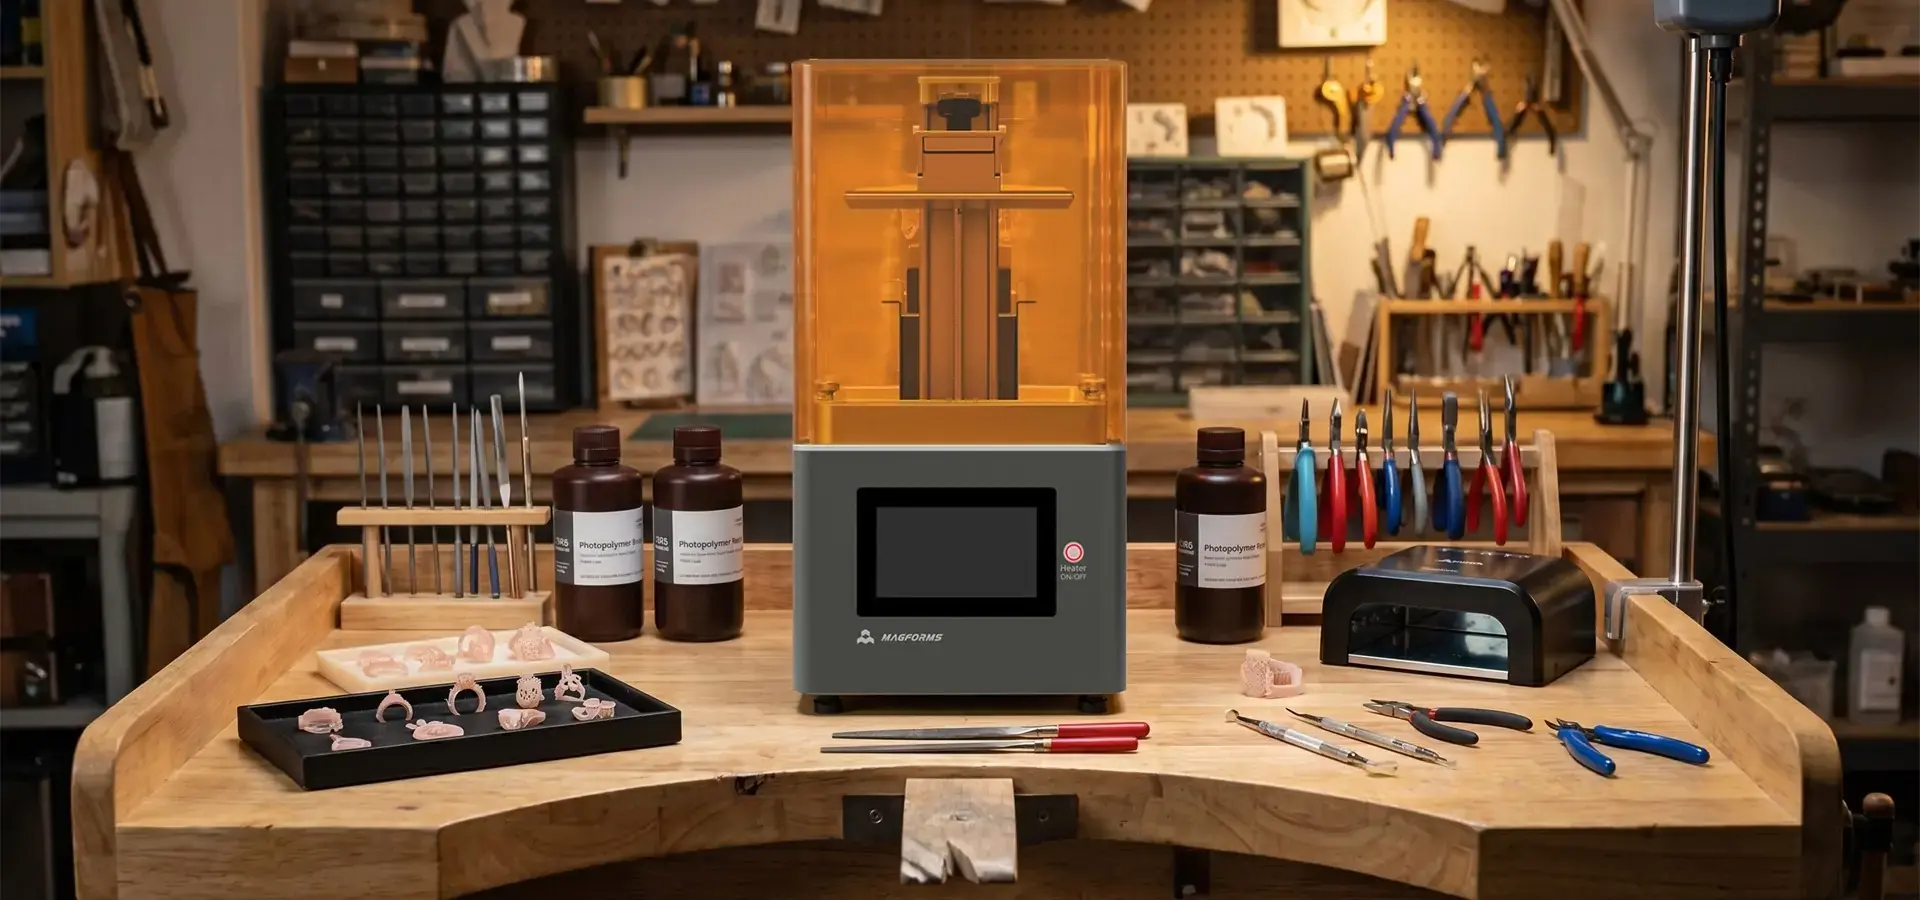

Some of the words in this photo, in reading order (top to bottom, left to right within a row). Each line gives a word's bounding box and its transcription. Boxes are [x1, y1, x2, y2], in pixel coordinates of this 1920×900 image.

[579, 540, 632, 551] Photopolymer
[679, 539, 732, 551] Photopolymer
[1204, 543, 1256, 555] Photopolymer
[1060, 564, 1088, 572] Heater
[881, 633, 944, 642] MAGFORMS
